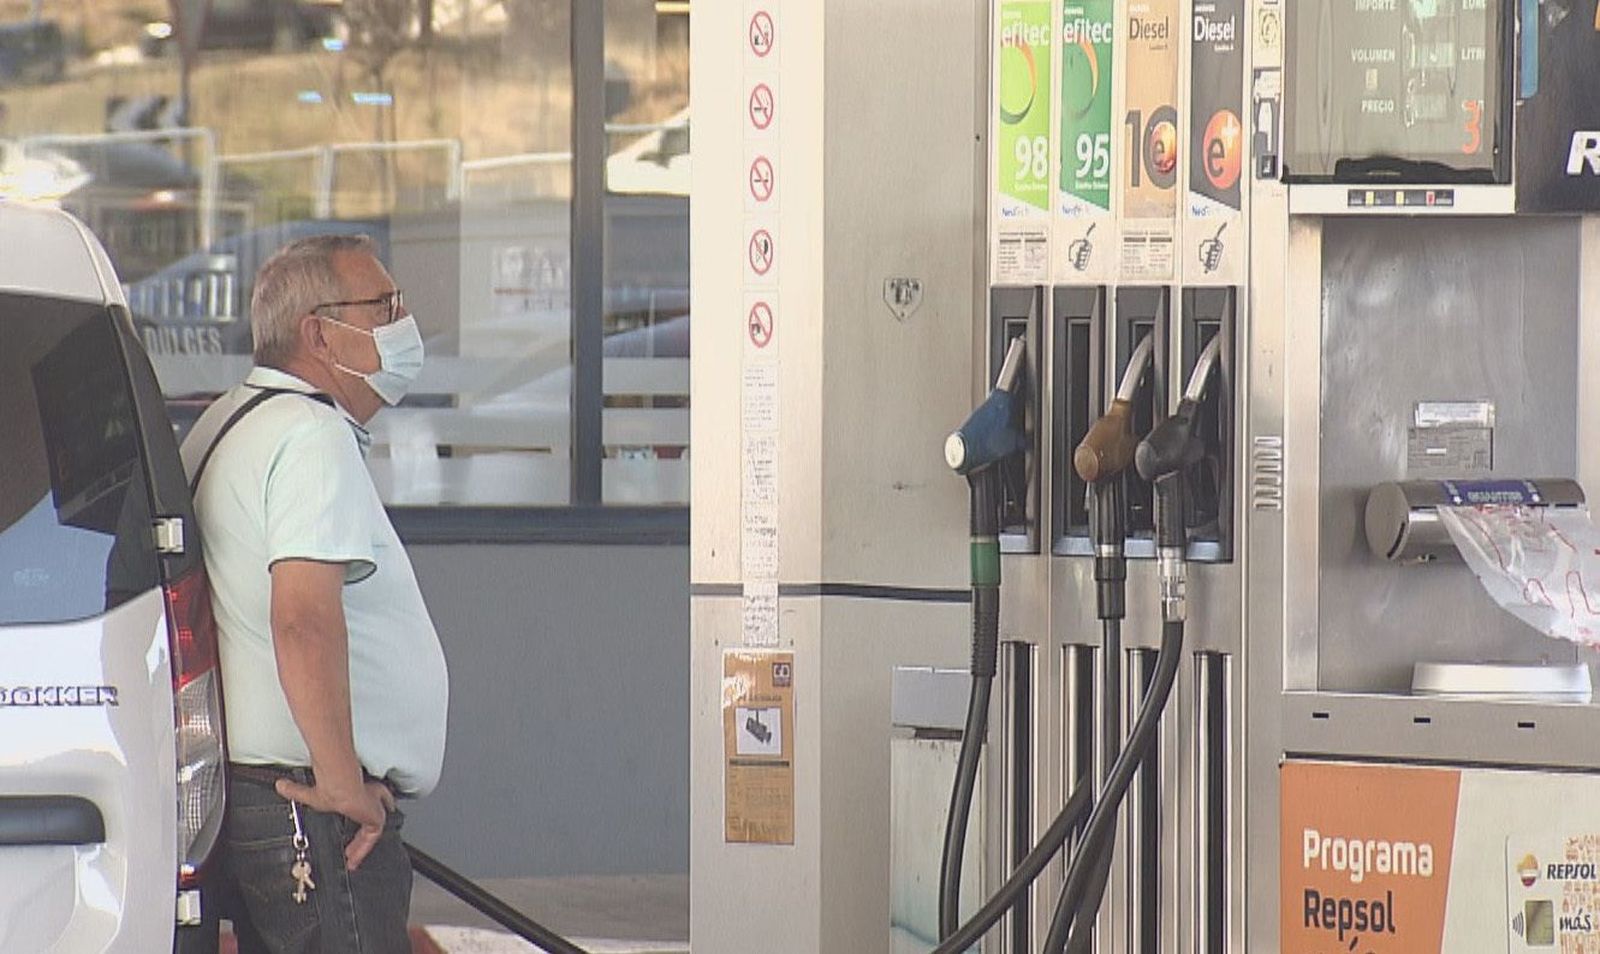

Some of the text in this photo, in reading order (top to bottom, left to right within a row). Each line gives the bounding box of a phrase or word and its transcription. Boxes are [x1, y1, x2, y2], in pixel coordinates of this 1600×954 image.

[1063, 18, 1112, 44] efitec
[1129, 16, 1169, 40] Diesel
[1194, 15, 1235, 41] Diesel
[1351, 48, 1396, 61] VOLUMEN
[1361, 100, 1394, 113] PRECIO
[1461, 100, 1482, 154] 3
[1014, 135, 1048, 181] 98
[1075, 133, 1110, 179] 95
[1303, 828, 1434, 883] Programa
[1546, 863, 1597, 880] REPSOL
[1303, 888, 1396, 942] Repsol
[1559, 908, 1592, 932] más
